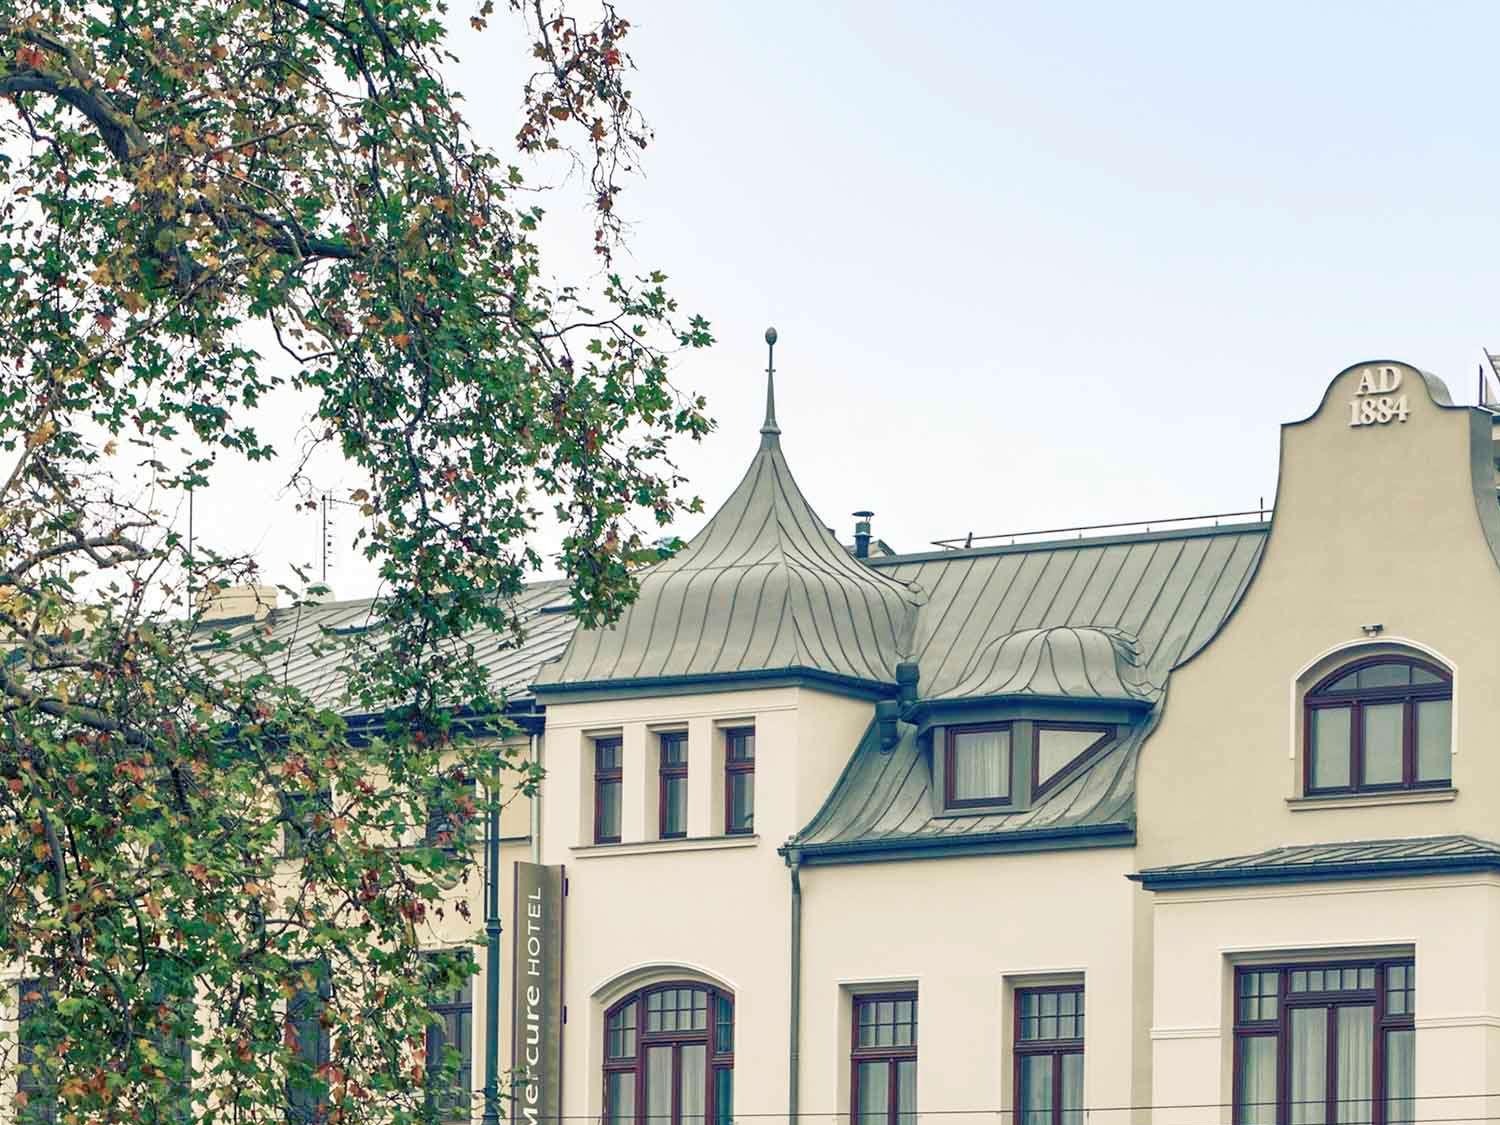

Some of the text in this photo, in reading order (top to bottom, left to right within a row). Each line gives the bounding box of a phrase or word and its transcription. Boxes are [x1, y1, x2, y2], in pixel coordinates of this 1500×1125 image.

[1353, 366, 1402, 397] AD
[1348, 394, 1413, 427] 1884
[527, 886, 542, 977] HOTEL
